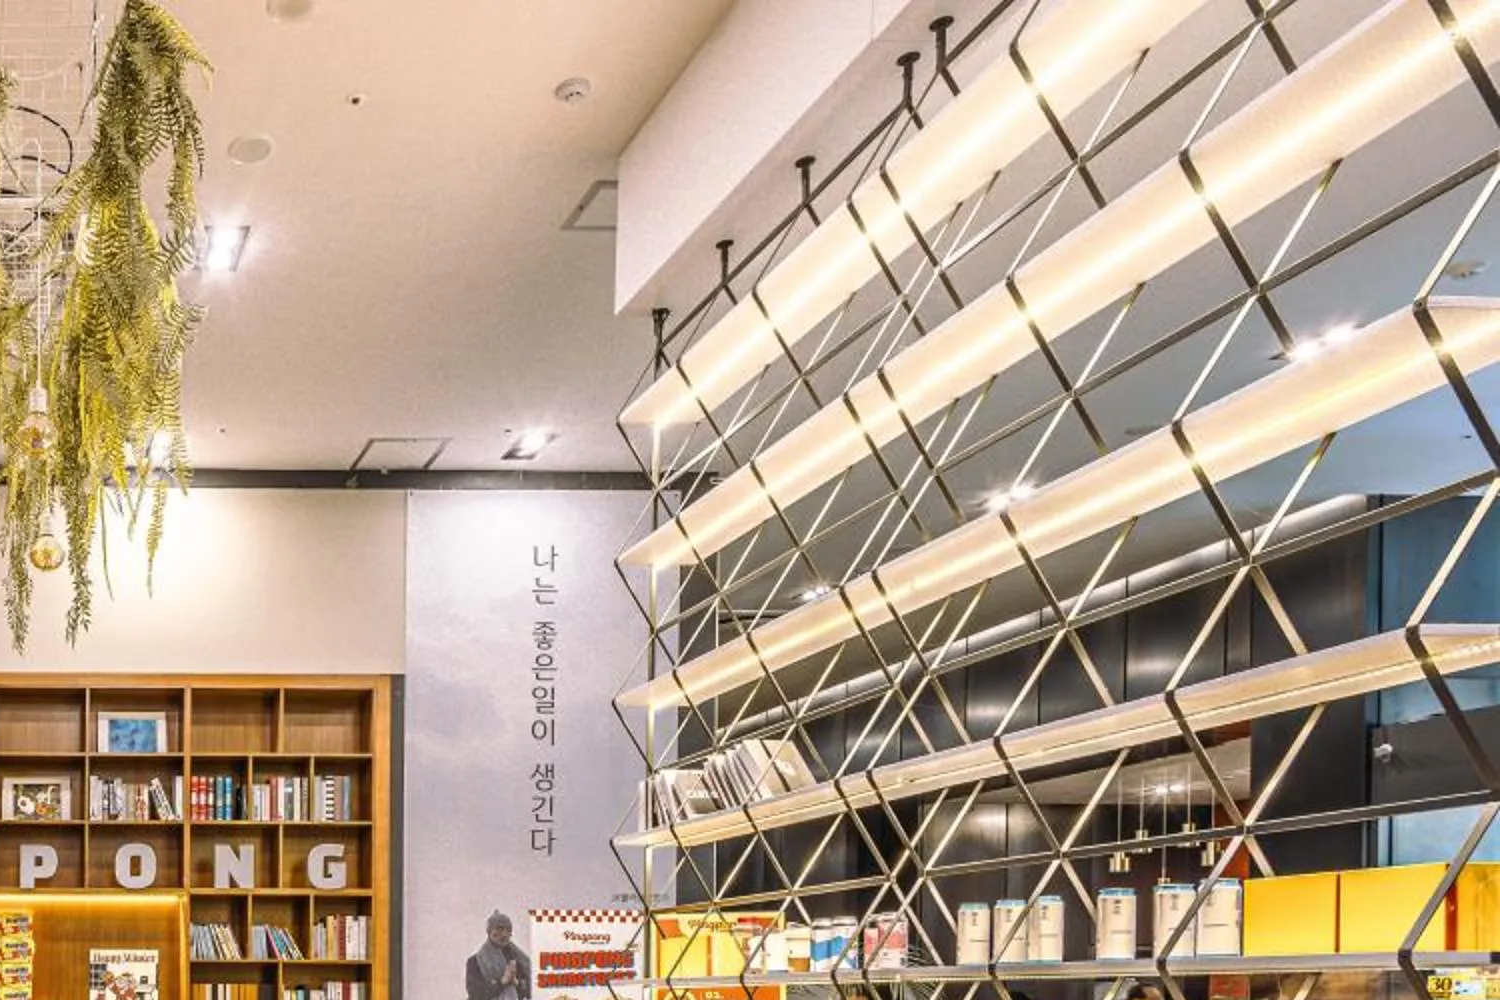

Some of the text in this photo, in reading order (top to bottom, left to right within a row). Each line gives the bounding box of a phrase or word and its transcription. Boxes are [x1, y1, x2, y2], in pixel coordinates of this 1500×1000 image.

[530, 545, 558, 856] 나는 좋은일이 생긴다
